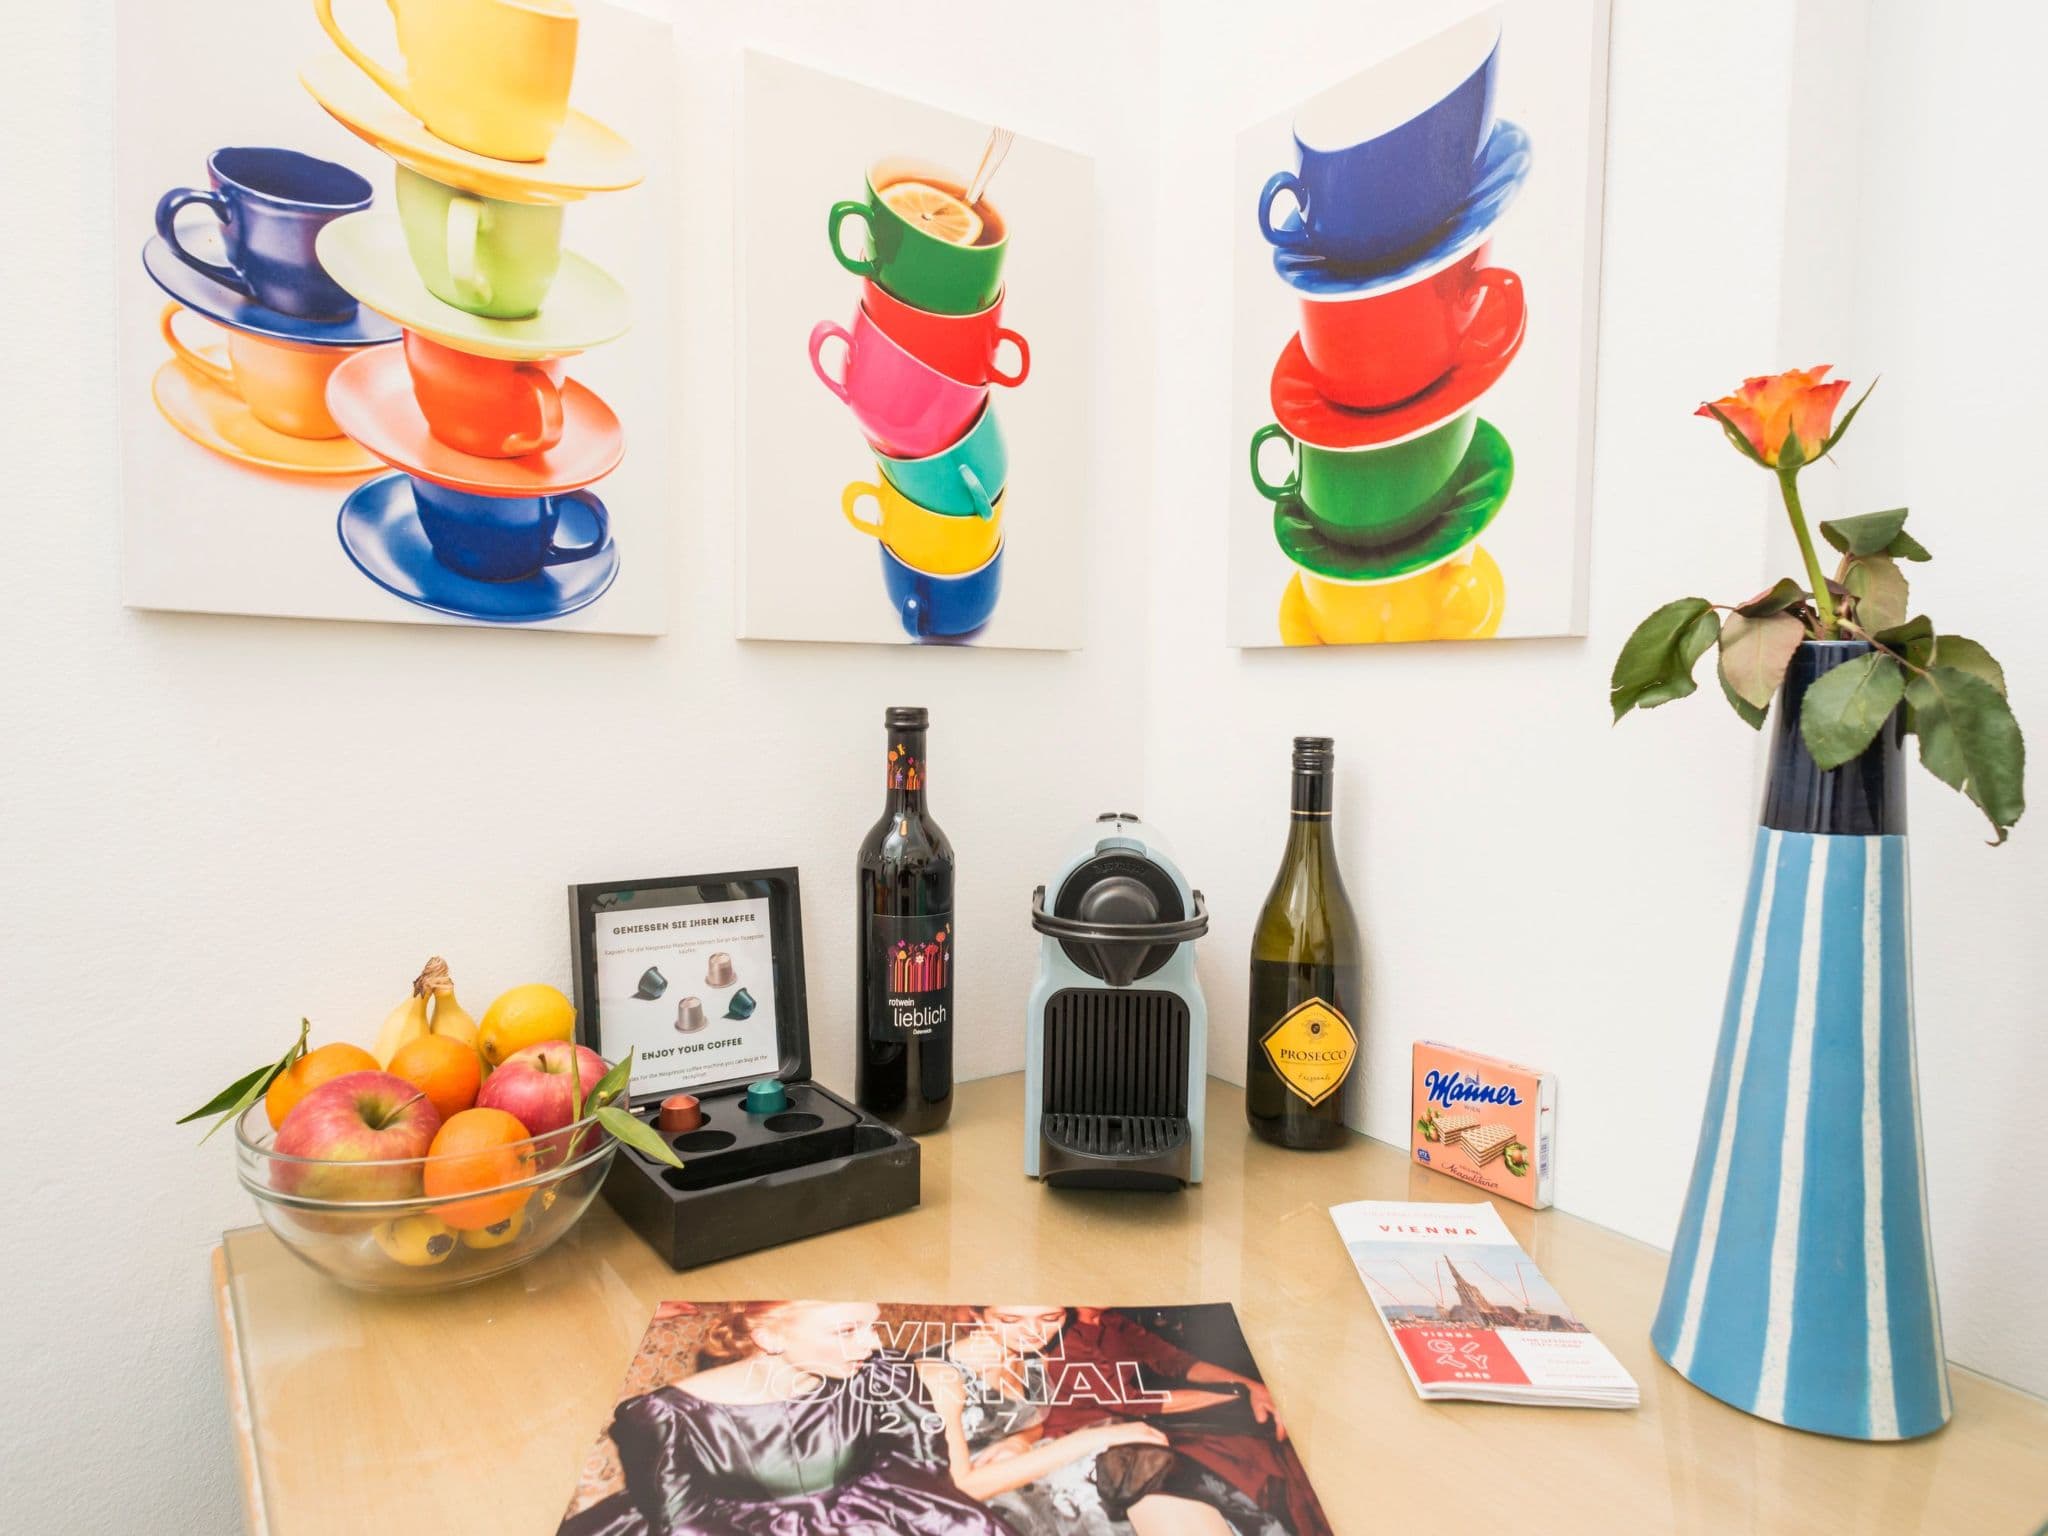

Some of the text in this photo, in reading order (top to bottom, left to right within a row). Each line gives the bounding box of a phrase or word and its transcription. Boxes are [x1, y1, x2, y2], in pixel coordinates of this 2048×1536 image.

[613, 913, 756, 935] GENIESSEN SIE IHREN KAFFEE
[888, 997, 915, 1007] rotwein
[894, 1004, 946, 1027] lieblich
[641, 1037, 743, 1060] ENJOY YOUR COFFEE
[1280, 1048, 1347, 1062] PROSECCO
[1425, 1069, 1522, 1108] Manner
[1379, 1224, 1478, 1235] VIENNA
[838, 1320, 1065, 1362] WIEN
[1421, 1331, 1473, 1339] VIENNA
[742, 1361, 1172, 1407] JOURNAL
